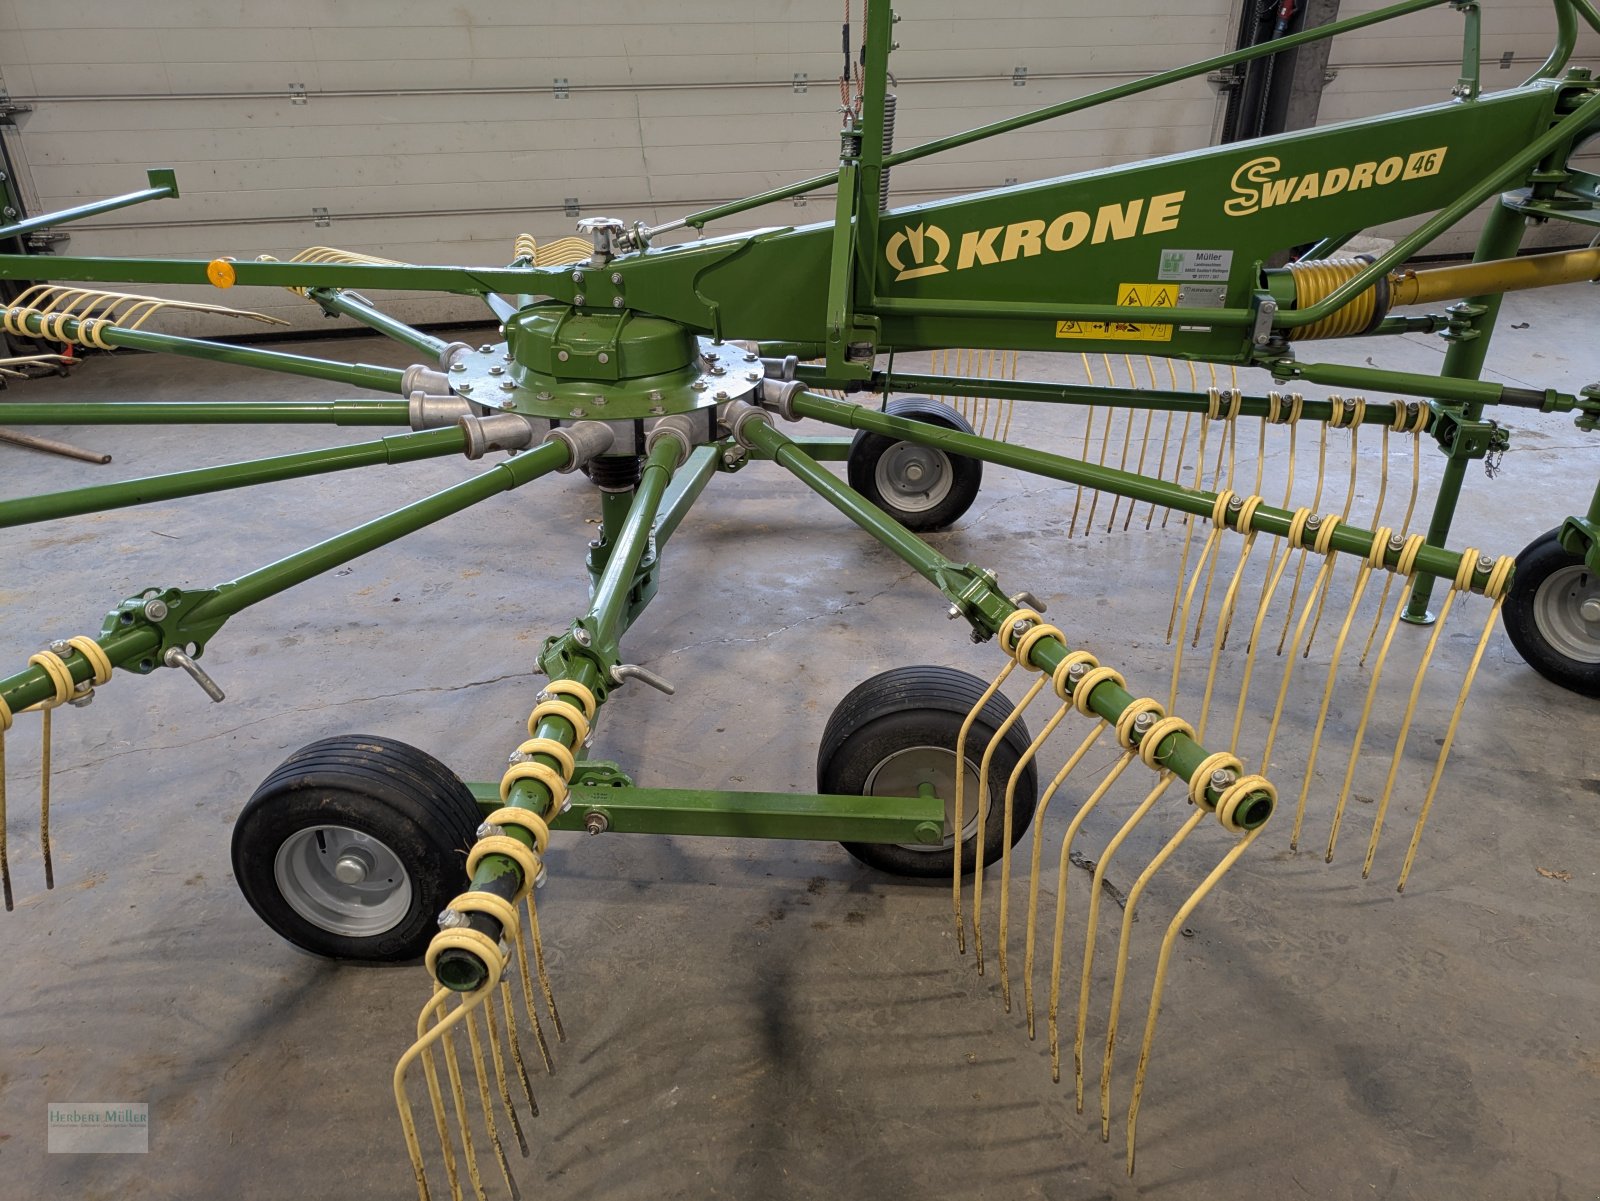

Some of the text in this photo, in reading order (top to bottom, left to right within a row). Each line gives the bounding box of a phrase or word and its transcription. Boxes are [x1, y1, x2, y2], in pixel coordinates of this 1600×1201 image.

[1223, 152, 1436, 217] SWADRO 46
[956, 190, 1186, 271] KRONE
[1195, 252, 1223, 261] Müller
